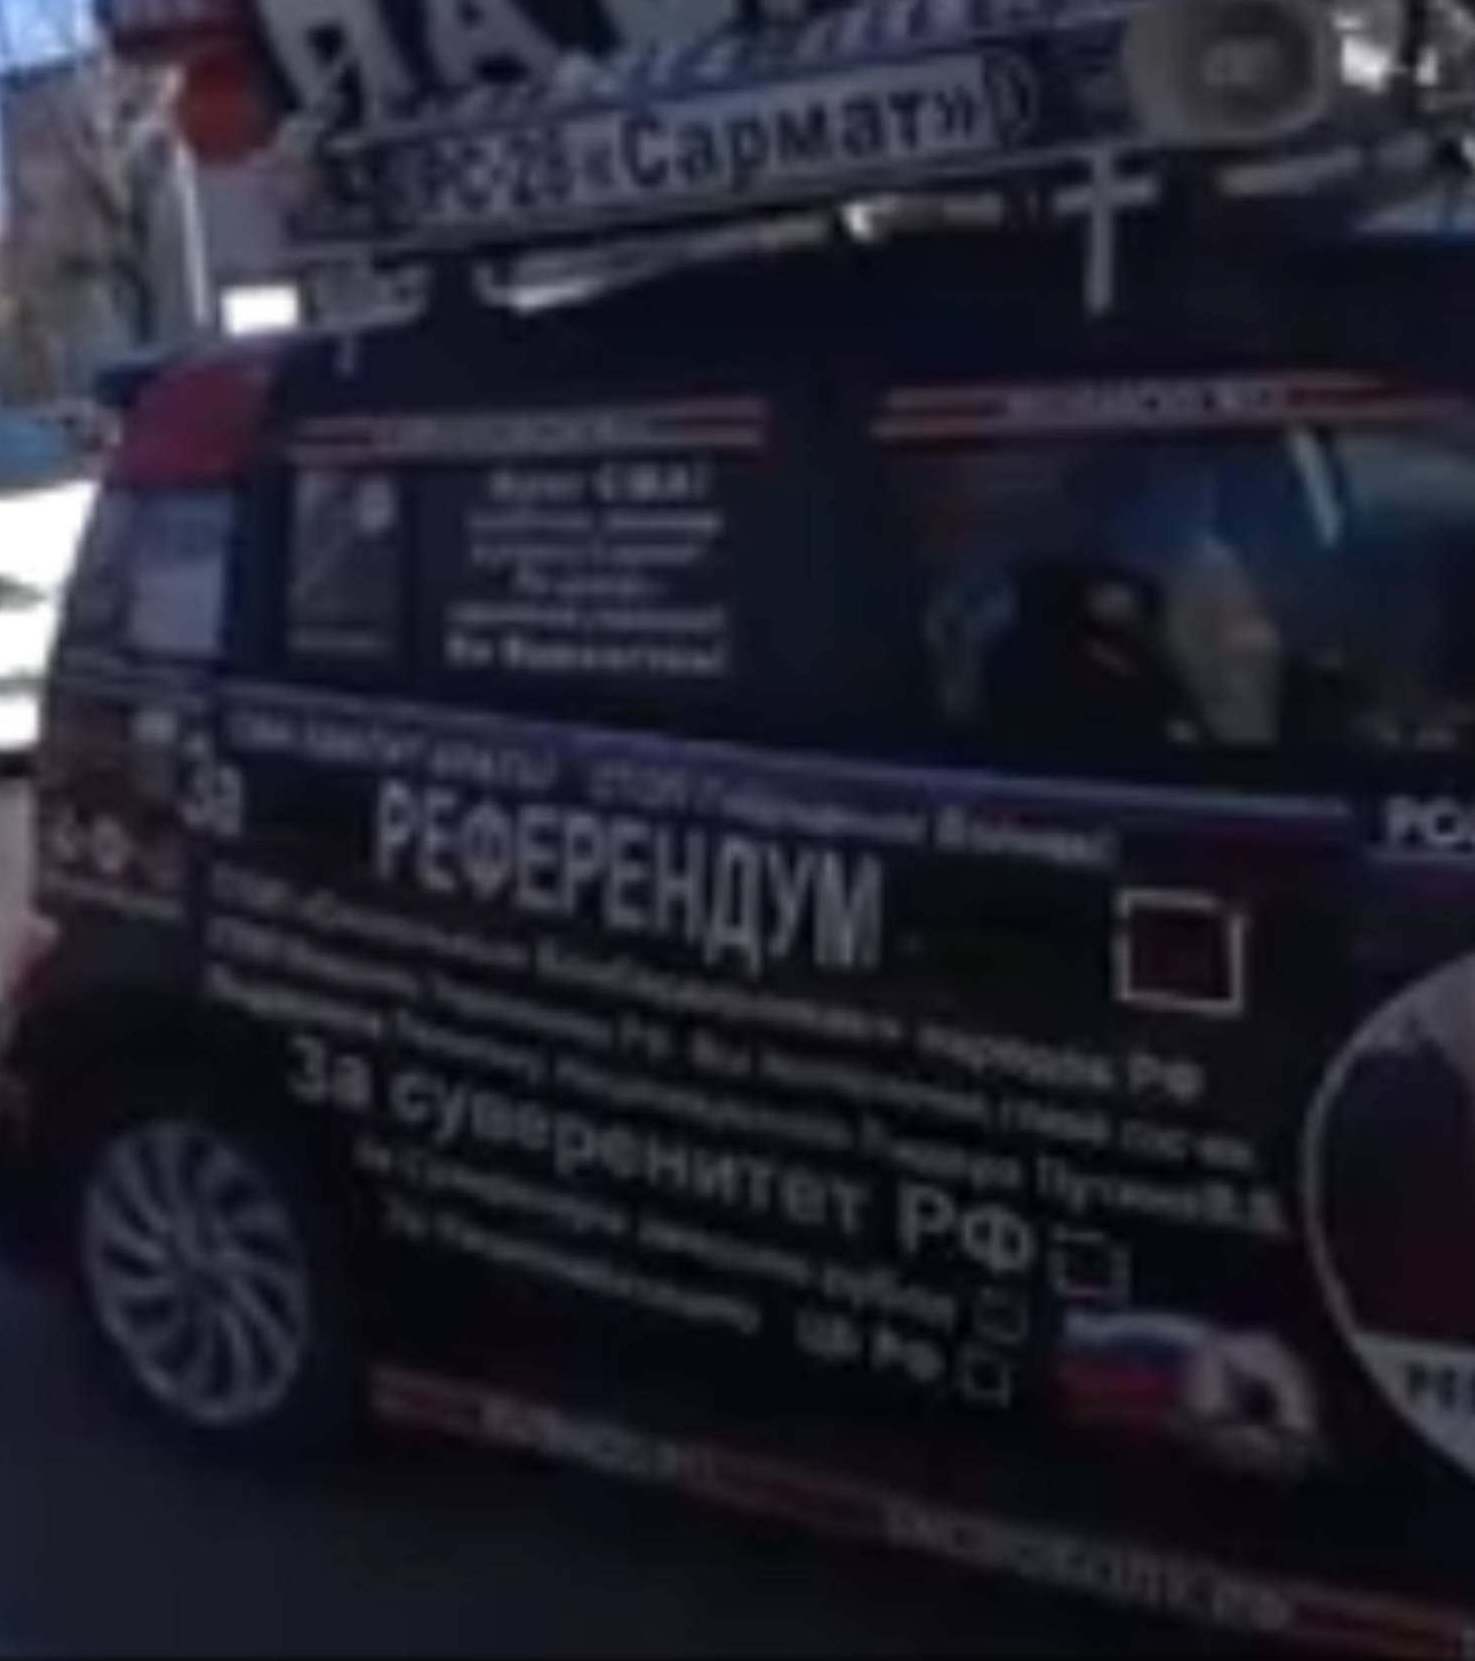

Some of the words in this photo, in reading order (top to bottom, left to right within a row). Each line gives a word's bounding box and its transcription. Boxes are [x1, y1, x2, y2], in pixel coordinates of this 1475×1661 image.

[371, 775, 886, 981] РЕФЕРЕНДУМ
[283, 1033, 373, 1111] За
[386, 1065, 877, 1243] суверенитет
[894, 1179, 1036, 1277] РФ
